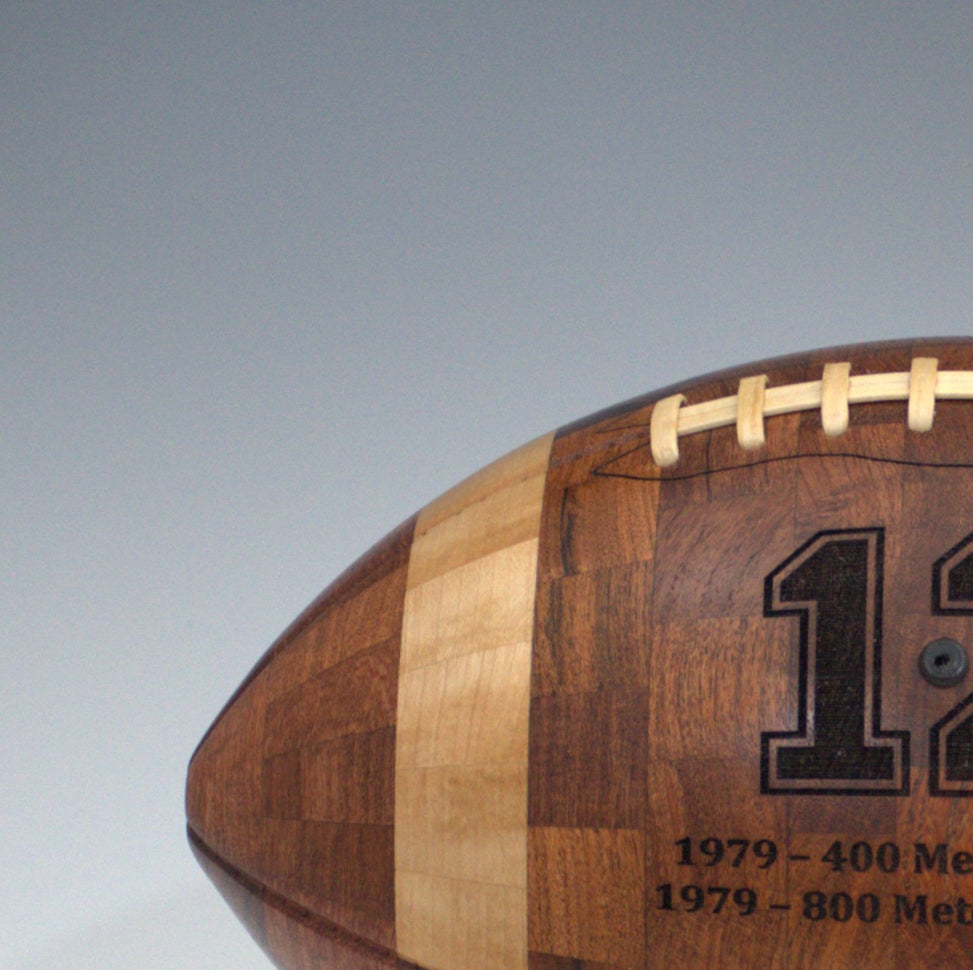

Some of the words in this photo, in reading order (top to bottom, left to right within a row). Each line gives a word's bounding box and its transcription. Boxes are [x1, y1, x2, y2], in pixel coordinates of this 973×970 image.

[674, 837, 779, 870] 1979
[821, 842, 899, 873] 400
[654, 883, 758, 917] 1979
[803, 891, 880, 922] 800
